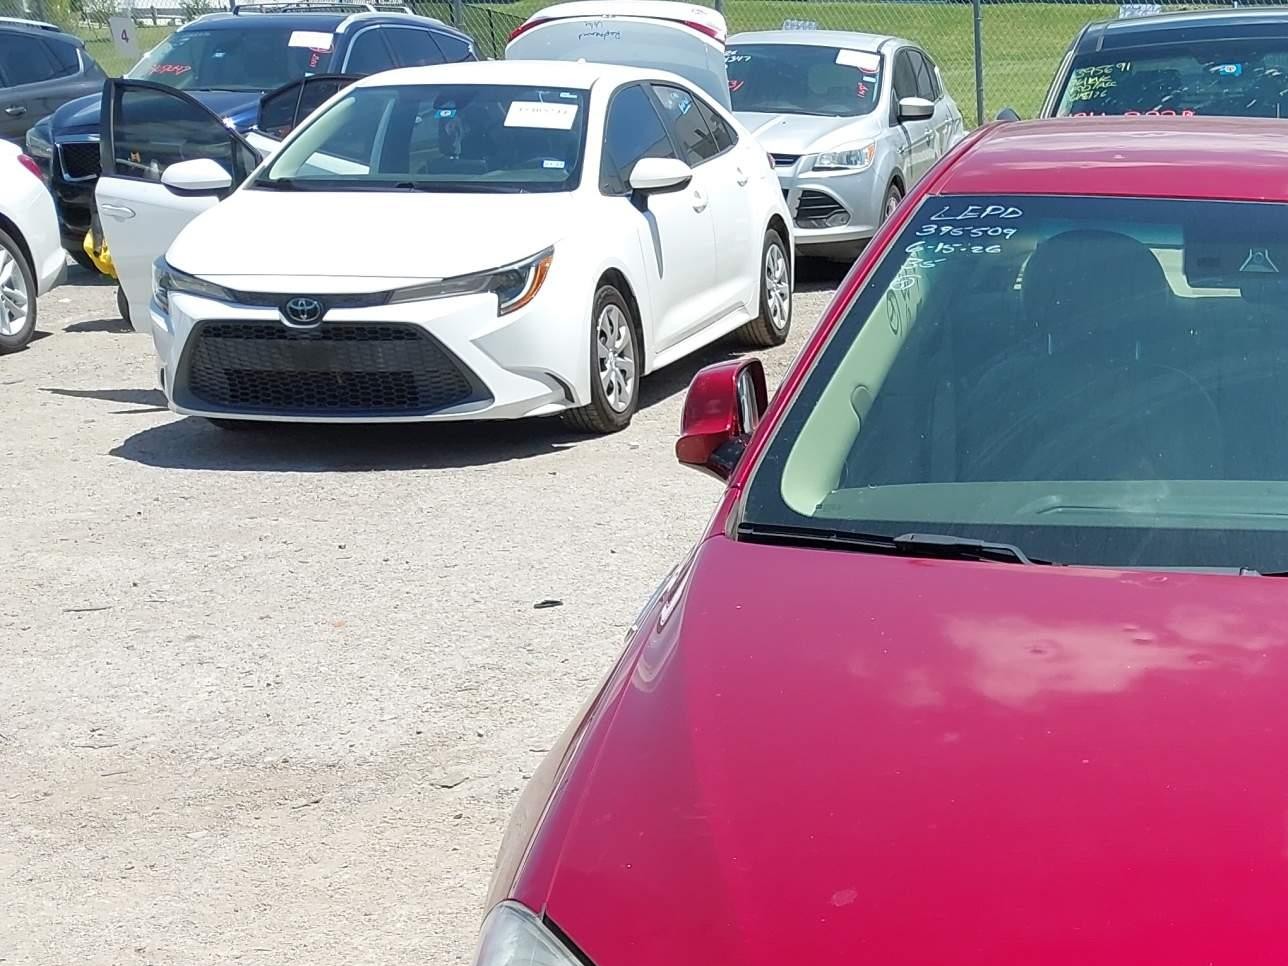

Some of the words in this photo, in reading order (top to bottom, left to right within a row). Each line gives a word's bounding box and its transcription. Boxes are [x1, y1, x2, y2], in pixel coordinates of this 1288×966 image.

[120, 29, 129, 43] 4
[930, 205, 1023, 220] LEPD
[915, 224, 1017, 239] 395509
